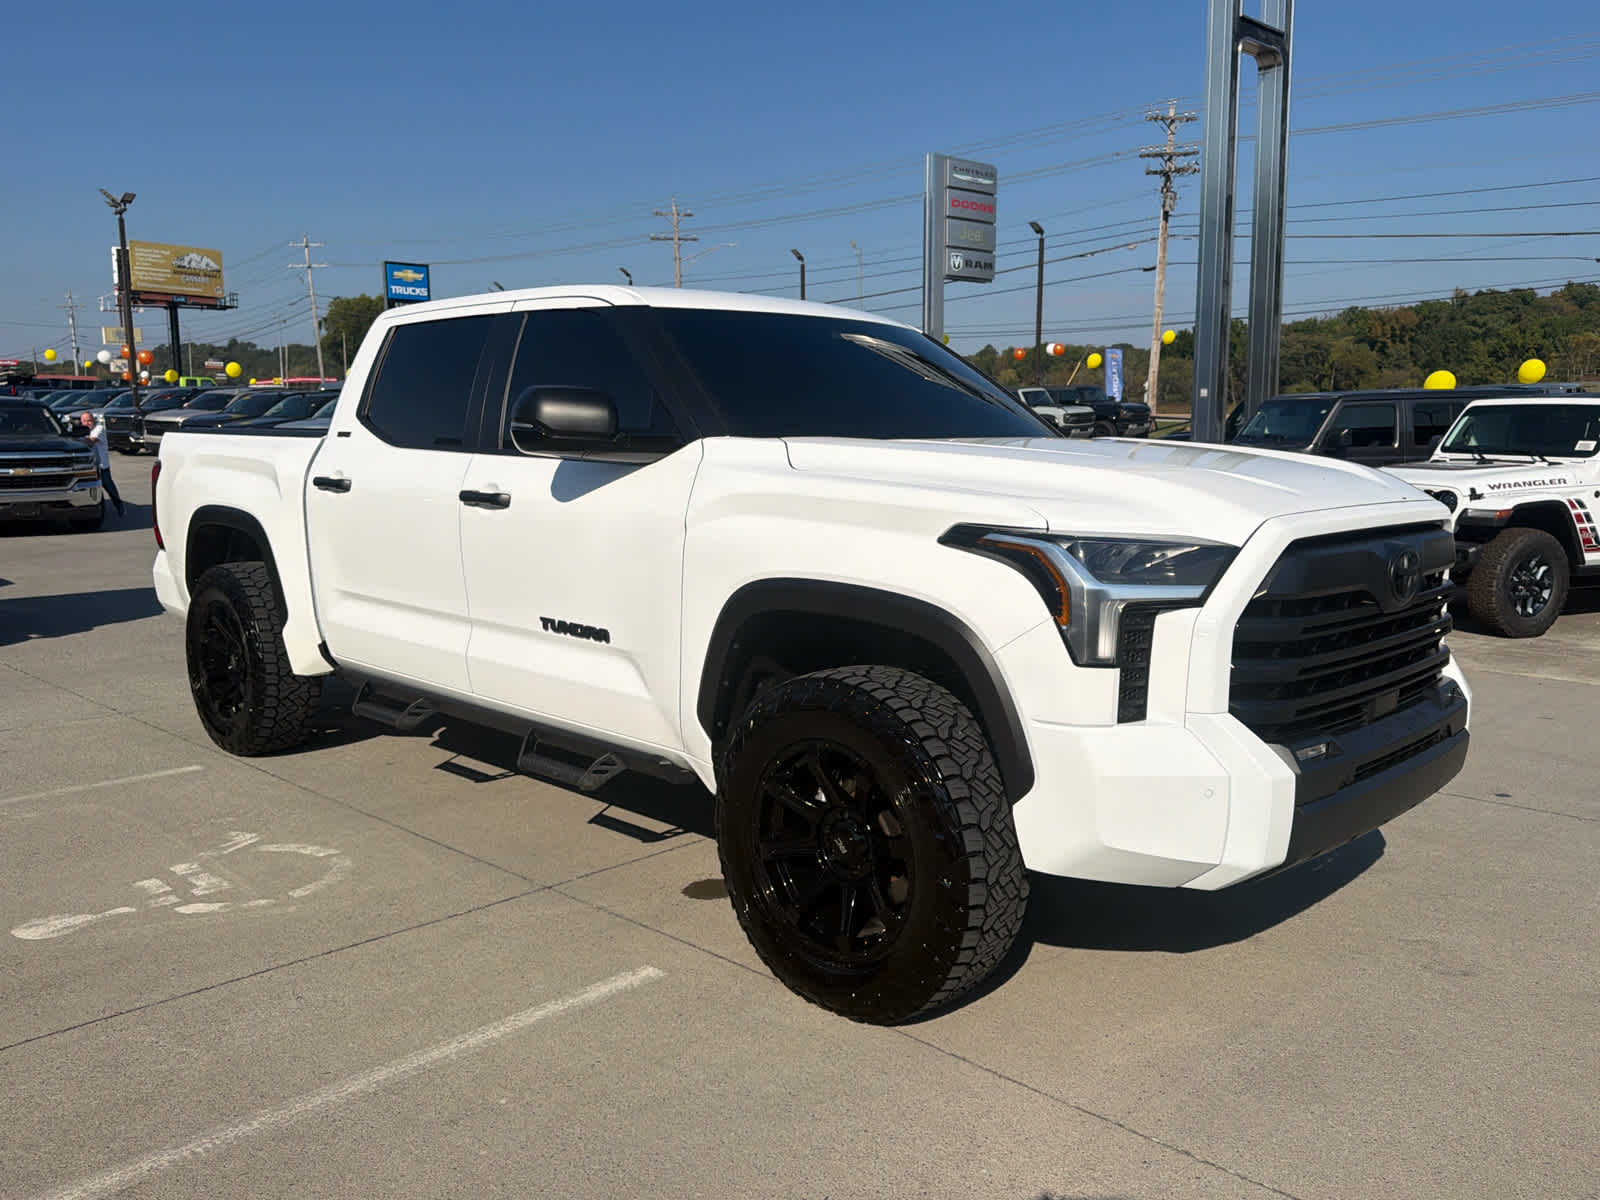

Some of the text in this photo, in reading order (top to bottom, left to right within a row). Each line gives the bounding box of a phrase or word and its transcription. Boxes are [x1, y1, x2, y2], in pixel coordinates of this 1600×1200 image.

[952, 166, 994, 178] CHRYSLER
[951, 198, 995, 214] DODGE
[965, 259, 993, 271] RAM
[391, 285, 428, 296] TRUCKS
[1487, 478, 1568, 491] WRANGLER
[539, 616, 611, 644] TUNDRA
